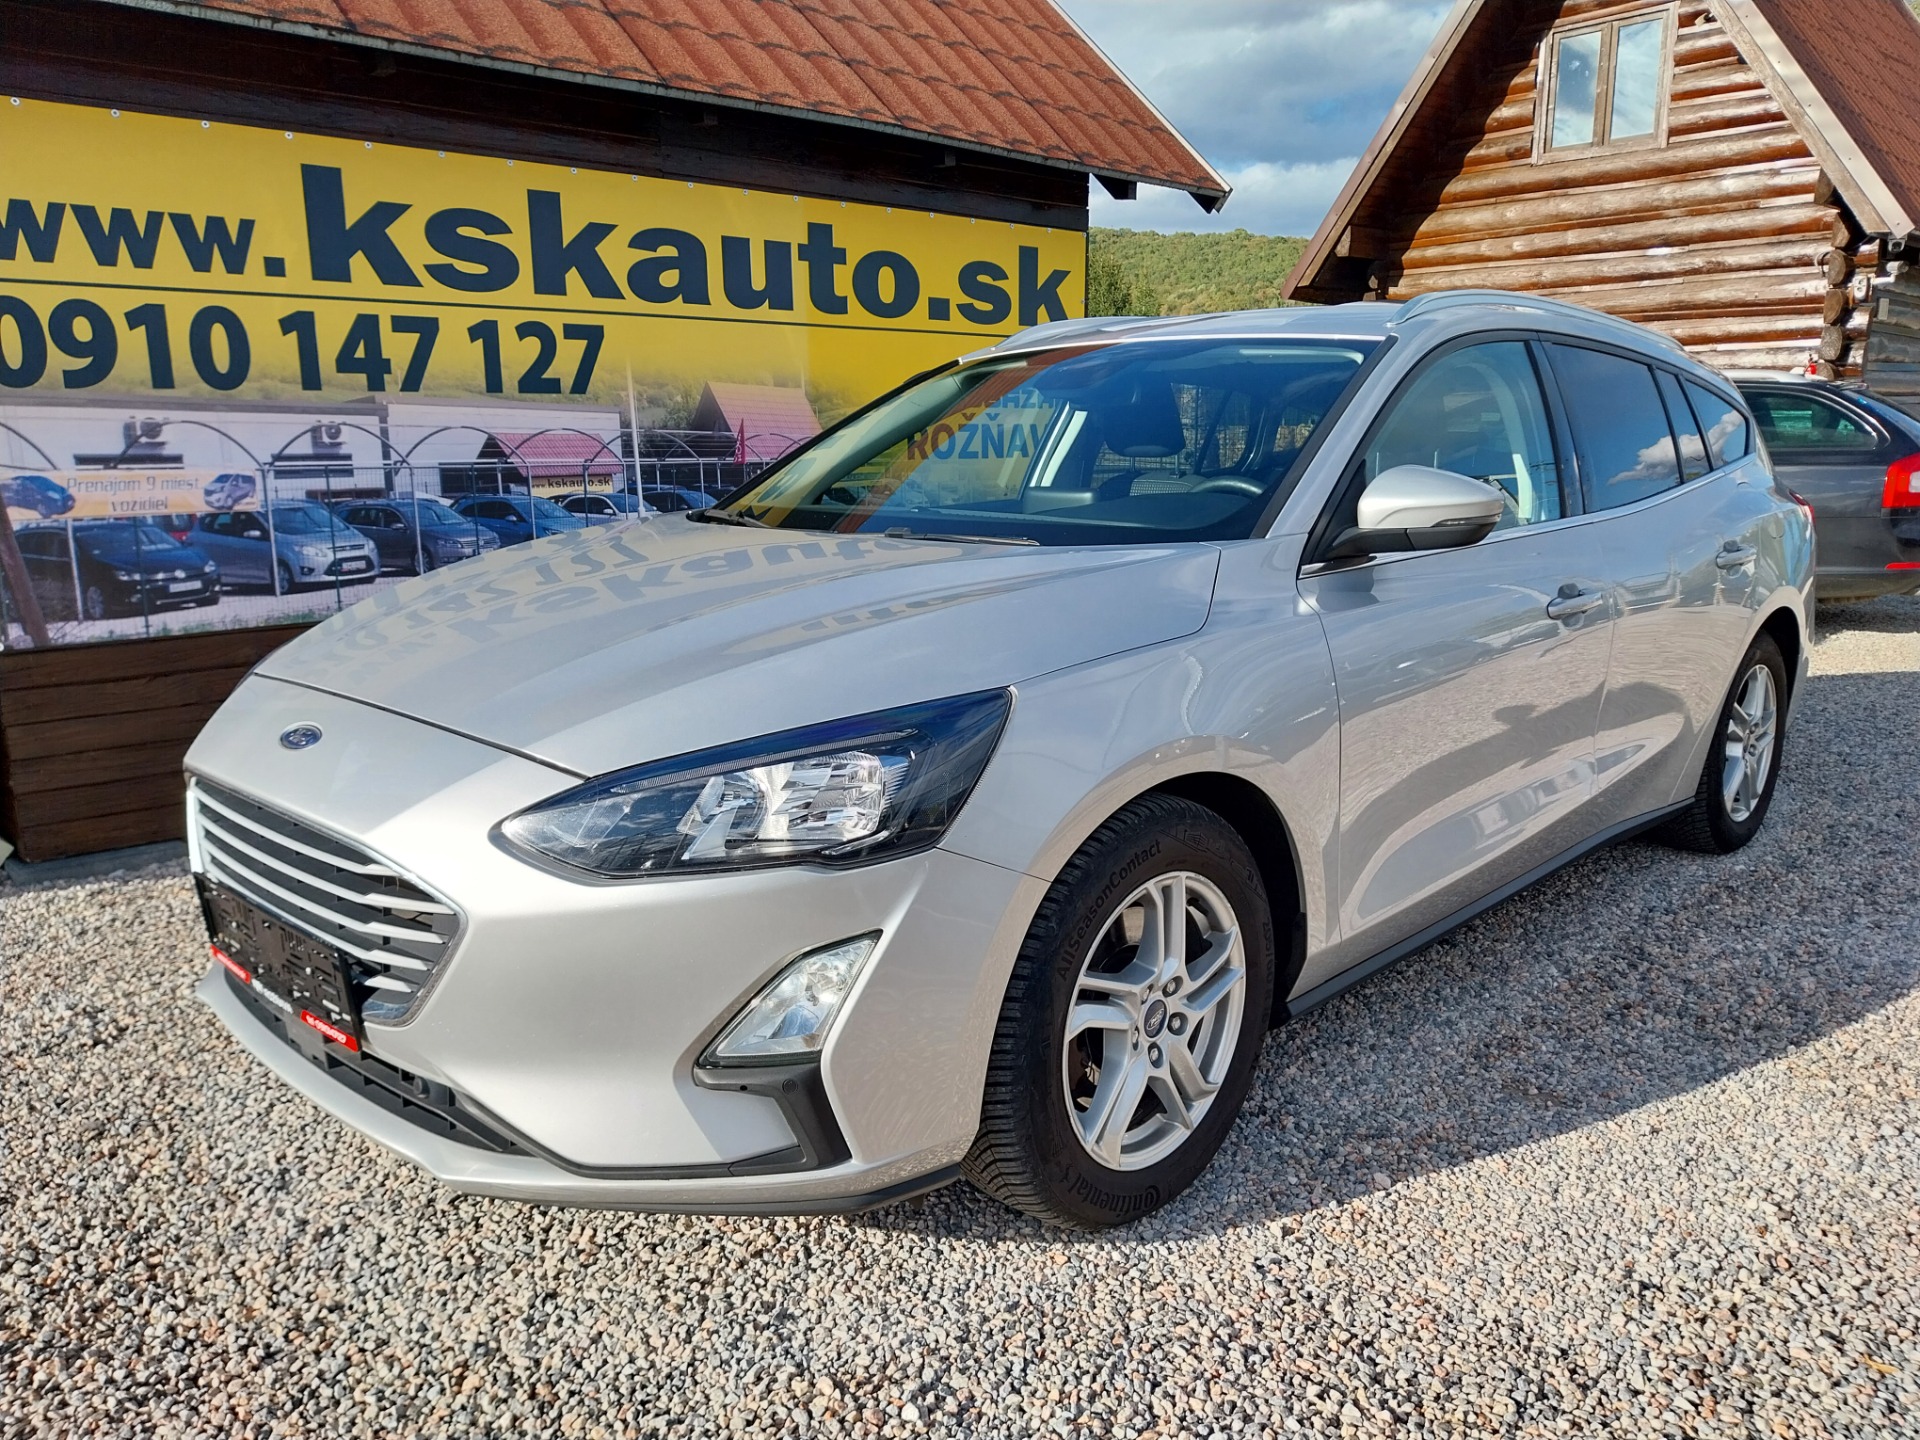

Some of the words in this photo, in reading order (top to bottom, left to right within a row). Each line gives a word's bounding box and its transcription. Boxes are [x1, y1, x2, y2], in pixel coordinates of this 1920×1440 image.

[0, 163, 1071, 327] www.kskauto.sk
[0, 295, 251, 392] 0910
[278, 310, 440, 392] 147
[467, 319, 605, 395] 127
[147, 477, 156, 490] 9
[161, 477, 200, 490] miest
[532, 477, 611, 489] www.kskauo.sk
[1057, 838, 1162, 981] AllSeasonContact
[1067, 1172, 1160, 1218] Continental
